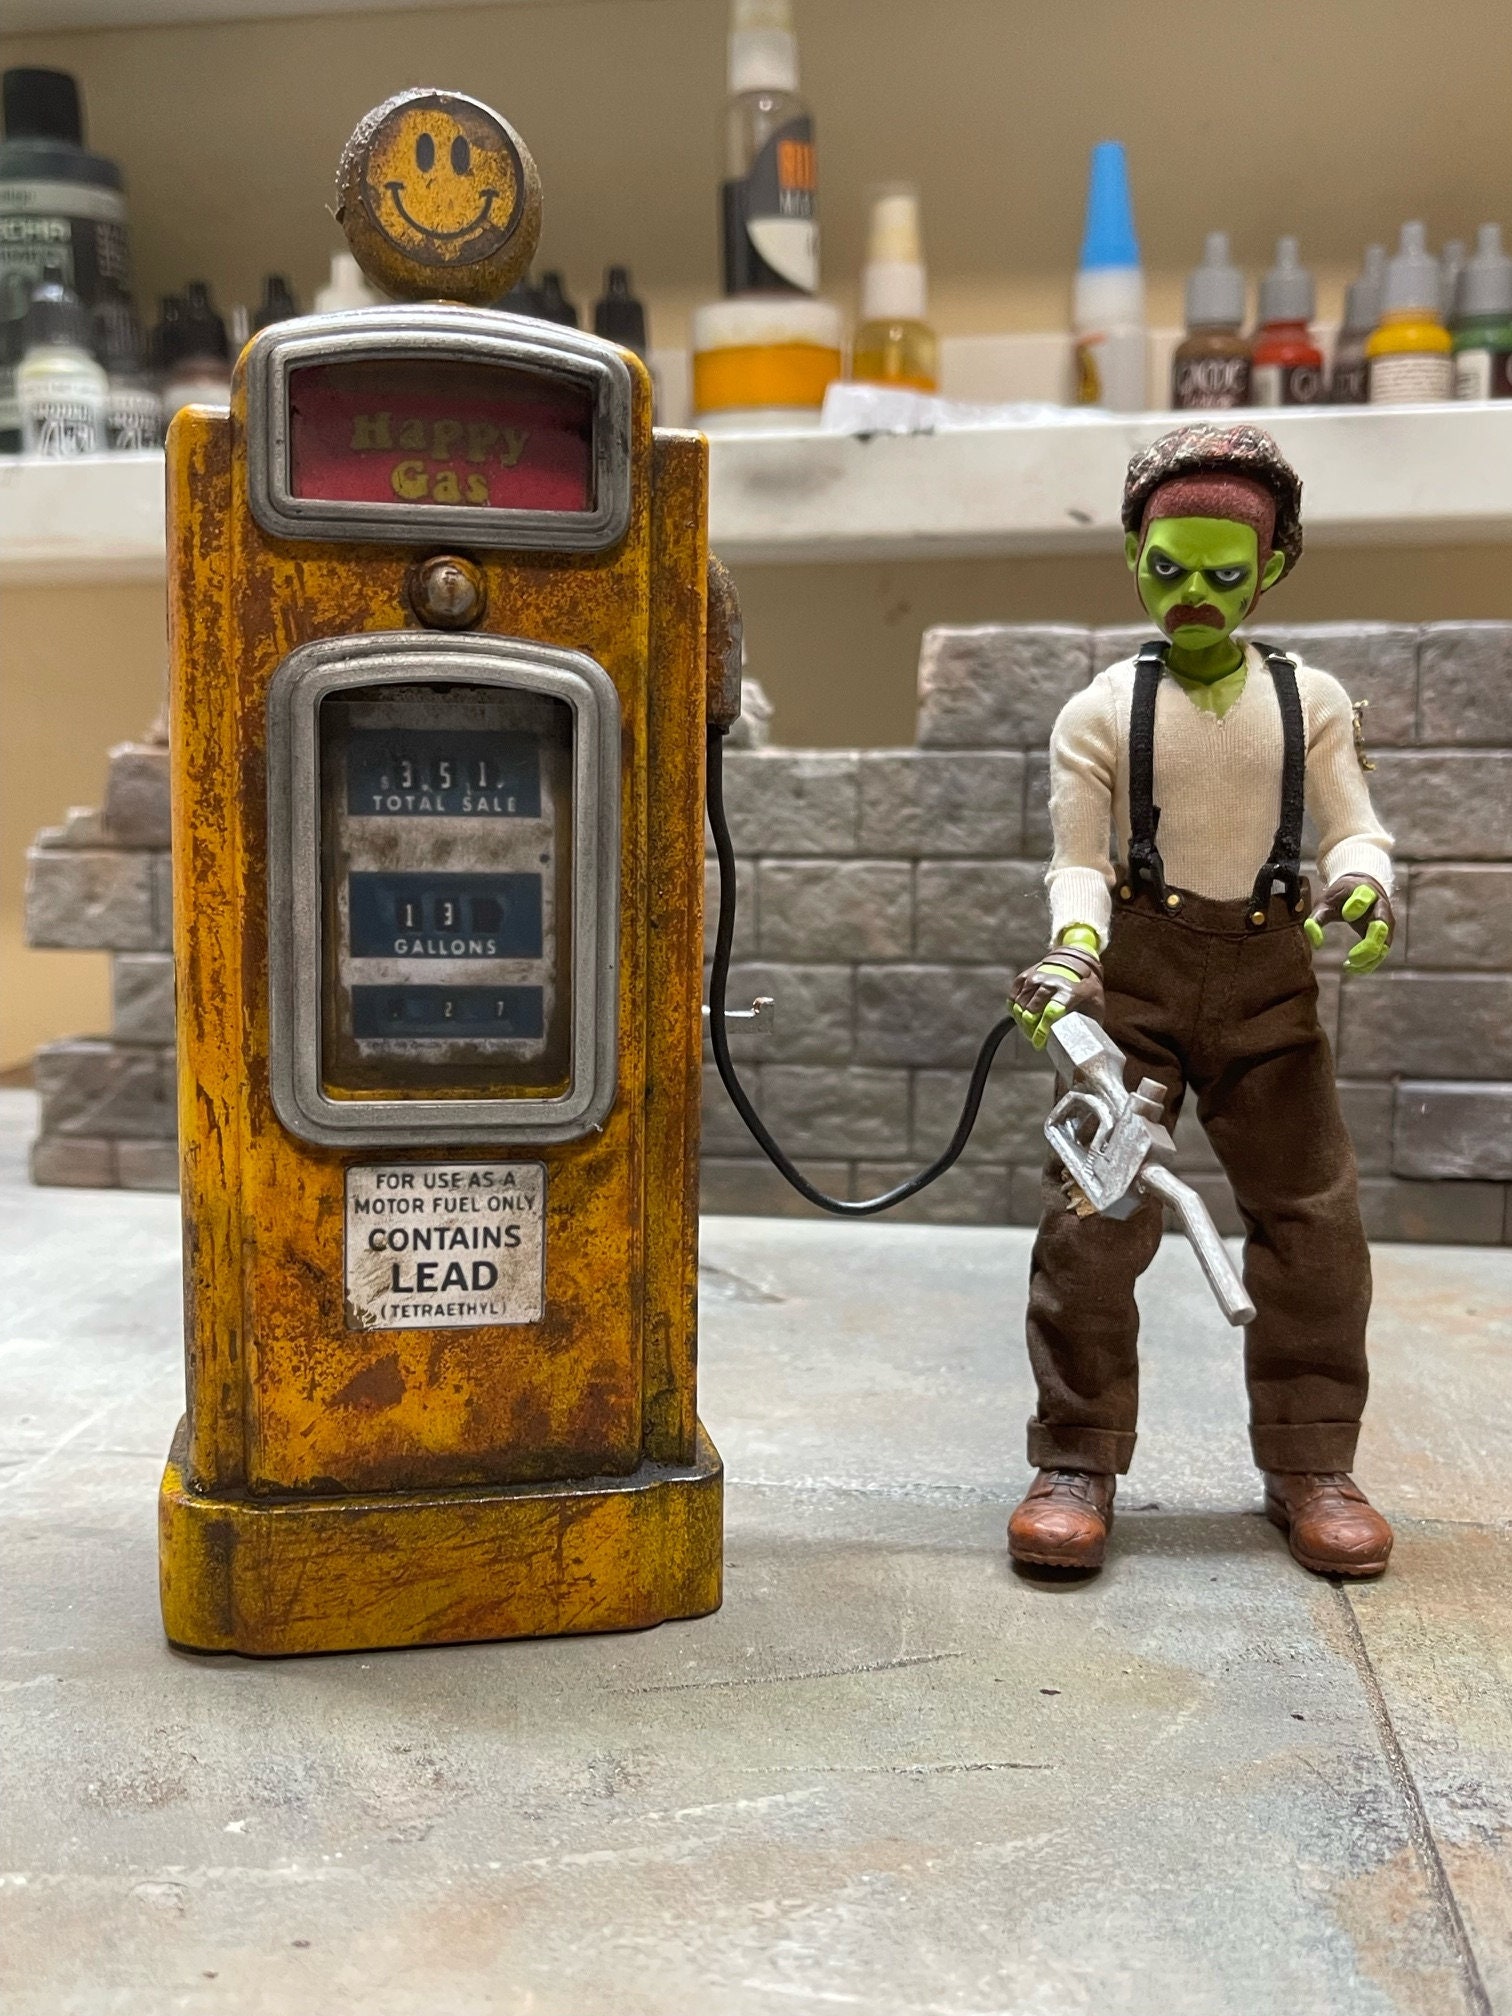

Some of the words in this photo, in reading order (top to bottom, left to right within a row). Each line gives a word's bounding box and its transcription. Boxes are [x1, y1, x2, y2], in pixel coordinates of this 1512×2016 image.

[352, 411, 530, 467] Happy
[390, 460, 490, 505] Gas
[372, 795, 445, 812] TOTAL
[462, 796, 517, 813] SALE
[394, 938, 497, 955] GALLONS
[376, 1173, 414, 1190] FOR
[423, 1172, 461, 1189] USE
[468, 1171, 494, 1188] AS
[503, 1171, 516, 1186] A
[354, 1198, 424, 1215] MOTOR
[433, 1197, 480, 1214] FUEL
[488, 1195, 536, 1212] ONLY
[367, 1224, 522, 1252] CONTAINS
[391, 1260, 499, 1294] LEAD
[380, 1302, 507, 1319] (TETRAETHYL)
